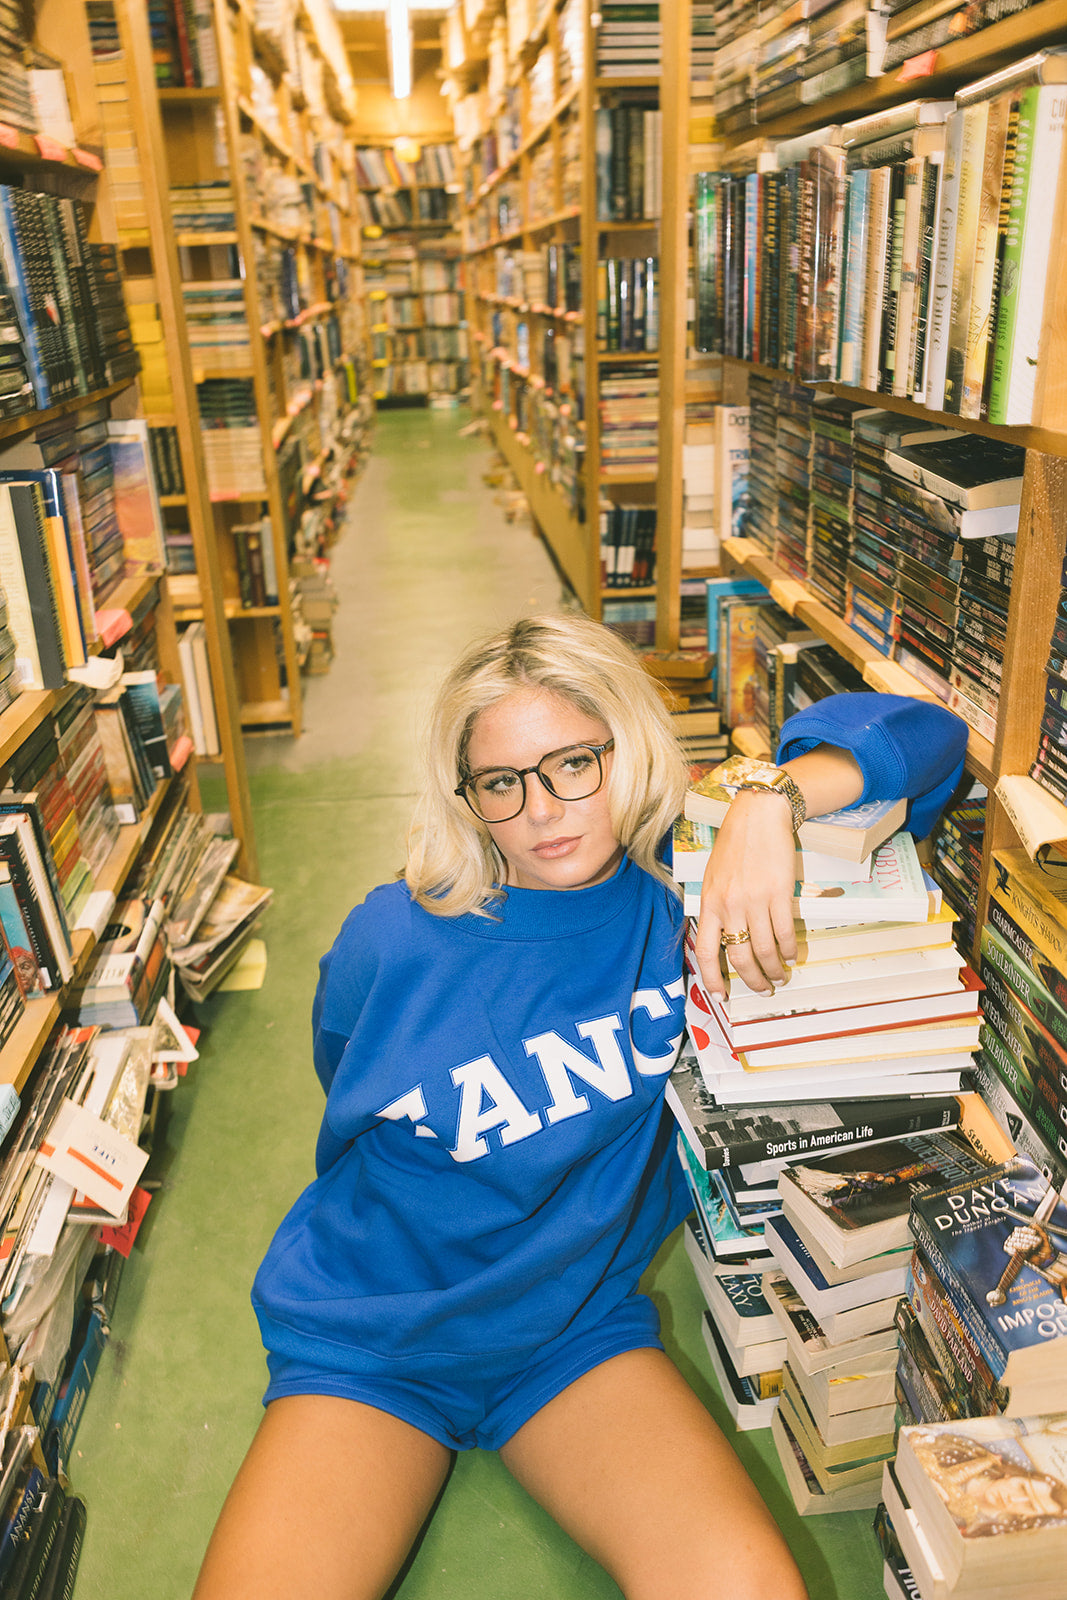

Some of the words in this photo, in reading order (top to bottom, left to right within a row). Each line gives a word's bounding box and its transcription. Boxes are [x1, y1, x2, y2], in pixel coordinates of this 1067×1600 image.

[997, 111, 1020, 236] RETROGRADE
[1011, 118, 1030, 208] KANGAROO
[1005, 217, 1021, 246] TOO
[997, 306, 1009, 341] CURTIS
[992, 359, 1004, 383] CHEN
[963, 625, 986, 644] DALMAS
[971, 619, 984, 633] JOHN
[992, 907, 1035, 969] CHARMCASTER
[1010, 891, 1039, 928] KNIGHT'S
[1038, 921, 1064, 955] SHADOW
[986, 938, 1032, 1008] SOULBINDER
[983, 967, 1024, 1037] QUEENSLAYER
[981, 995, 1023, 1067] QUEENSLAYER
[375, 975, 687, 1163] ANC
[766, 1141, 798, 1156] Sports
[799, 1137, 808, 1149] in
[810, 1131, 854, 1148] American
[856, 1125, 874, 1140] Life
[934, 1183, 1048, 1231] DUNCAN
[947, 1177, 1016, 1211] DAVE
[917, 1231, 948, 1280] DUNCAN
[719, 1275, 753, 1308] LAXY
[741, 1274, 763, 1297] TO
[942, 1292, 961, 1319] DAVID
[954, 1316, 982, 1358] FARLAND
[997, 1298, 1067, 1333] IMPOS
[927, 1299, 950, 1333] DAVID
[944, 1331, 974, 1383] FARLAND
[10, 1488, 36, 1549] ANANSI
